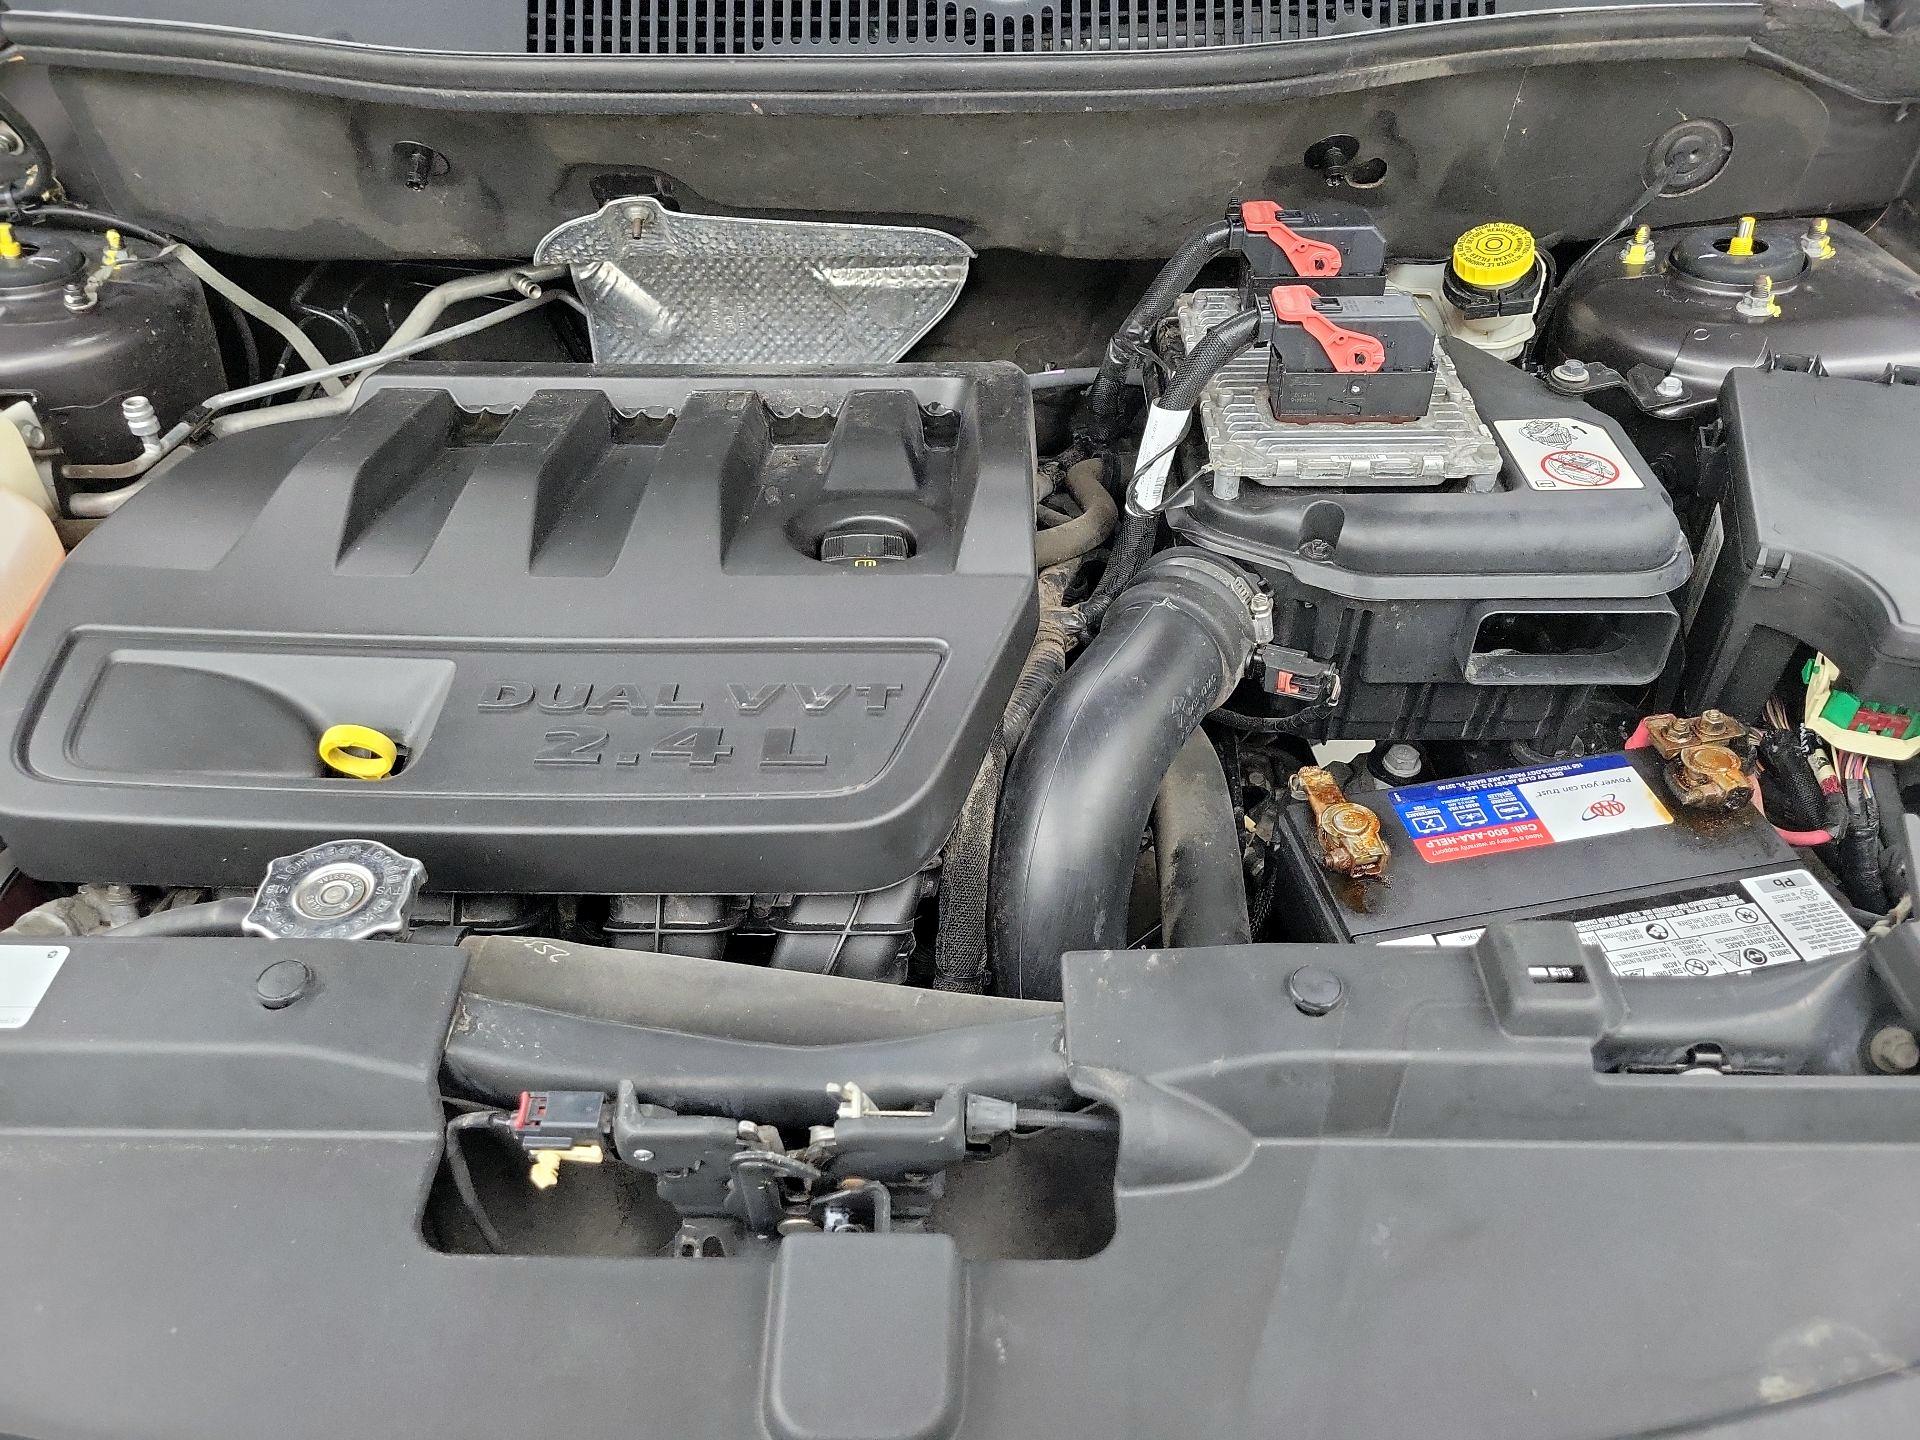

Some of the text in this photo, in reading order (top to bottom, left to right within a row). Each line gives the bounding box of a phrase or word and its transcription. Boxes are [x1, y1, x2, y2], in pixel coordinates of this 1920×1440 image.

[477, 682, 904, 715] DUAL VVT
[533, 725, 828, 768] 2.4 L
[1578, 781, 1599, 789] you
[1599, 776, 1633, 786] Power
[1423, 822, 1539, 848] Call: 800-AAA-HELP
[1771, 876, 1796, 889] Pb
[375, 885, 401, 894] TVS
[1723, 934, 1780, 949] EXPLOSIVE GASES
[1767, 941, 1786, 949] EYES
[1767, 948, 1792, 957] SHIELD
[1661, 961, 1678, 969] ACID
